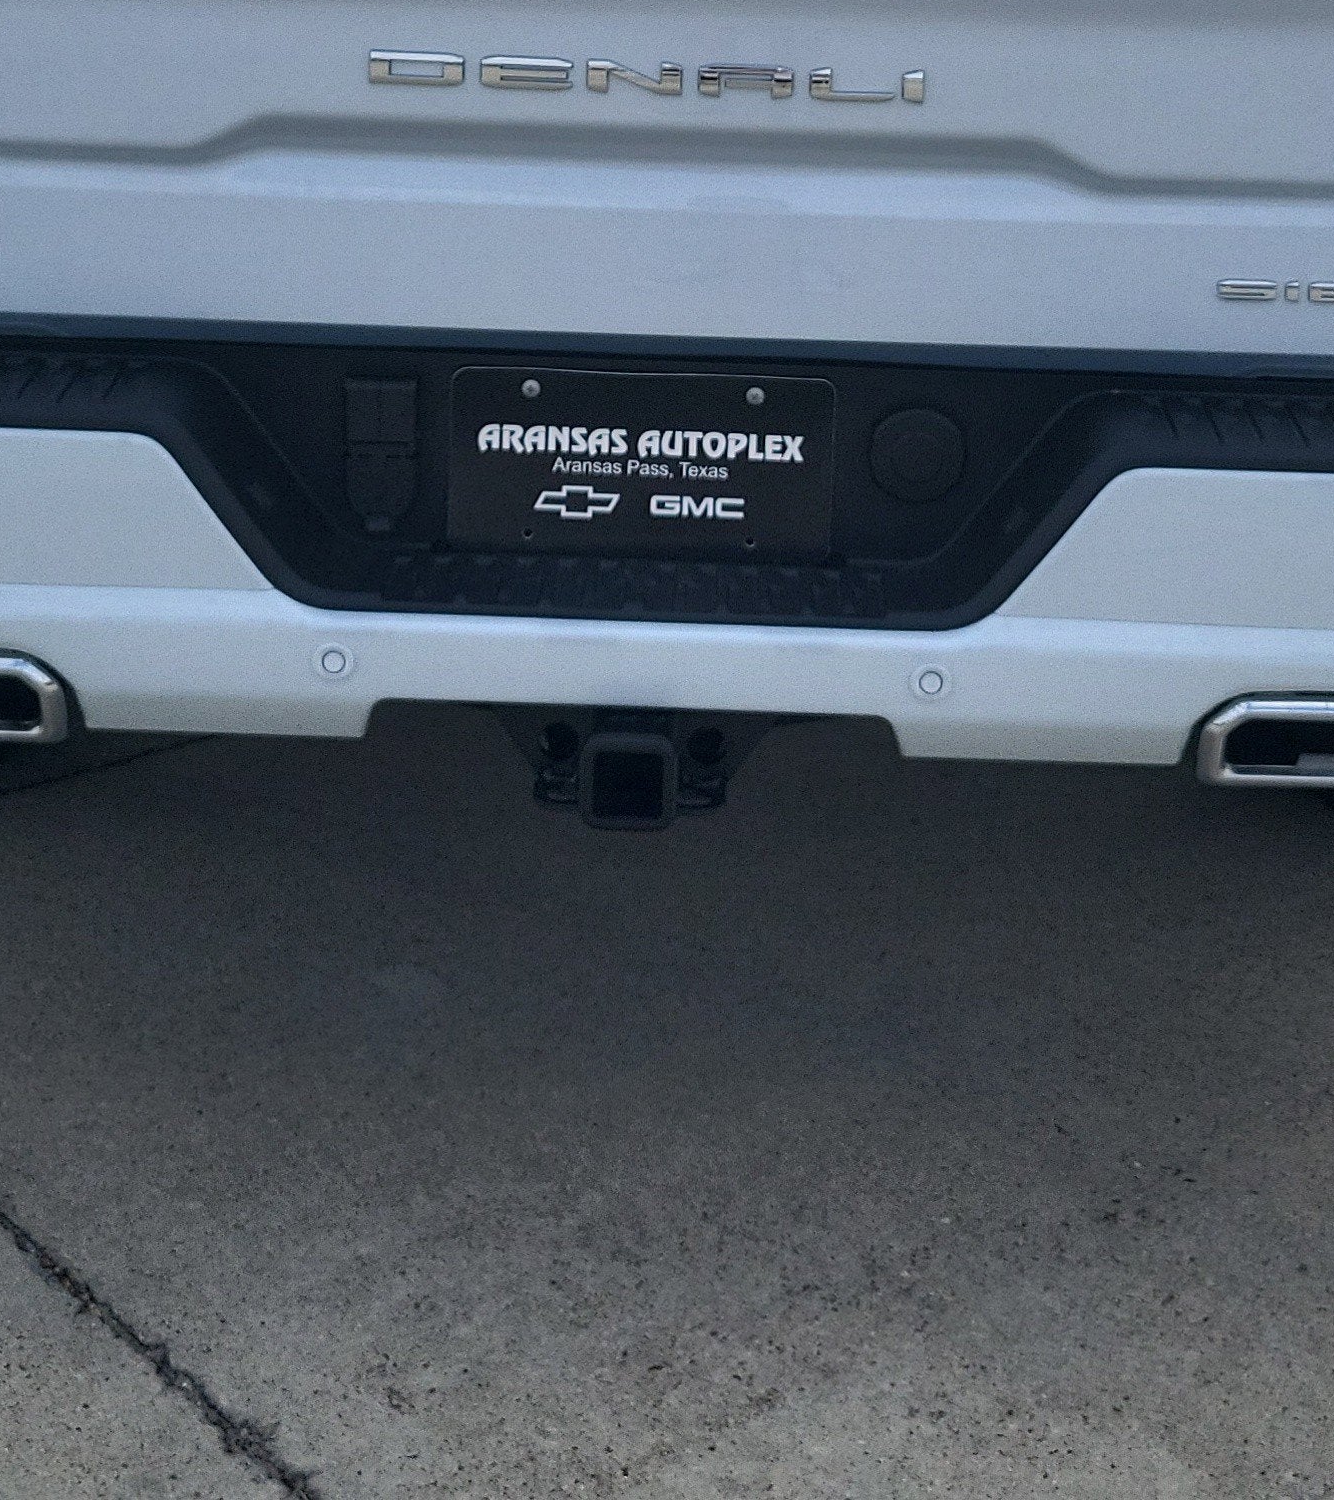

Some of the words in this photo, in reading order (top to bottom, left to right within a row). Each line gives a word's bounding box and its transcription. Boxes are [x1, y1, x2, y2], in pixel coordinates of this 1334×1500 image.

[368, 48, 927, 103] DENALI
[478, 423, 629, 456] ARANSAS
[638, 429, 805, 463] AUTOPLEX
[552, 457, 622, 475] Aransas
[626, 459, 674, 479] Pass,
[679, 461, 729, 479] Texas
[649, 494, 745, 519] GMC
